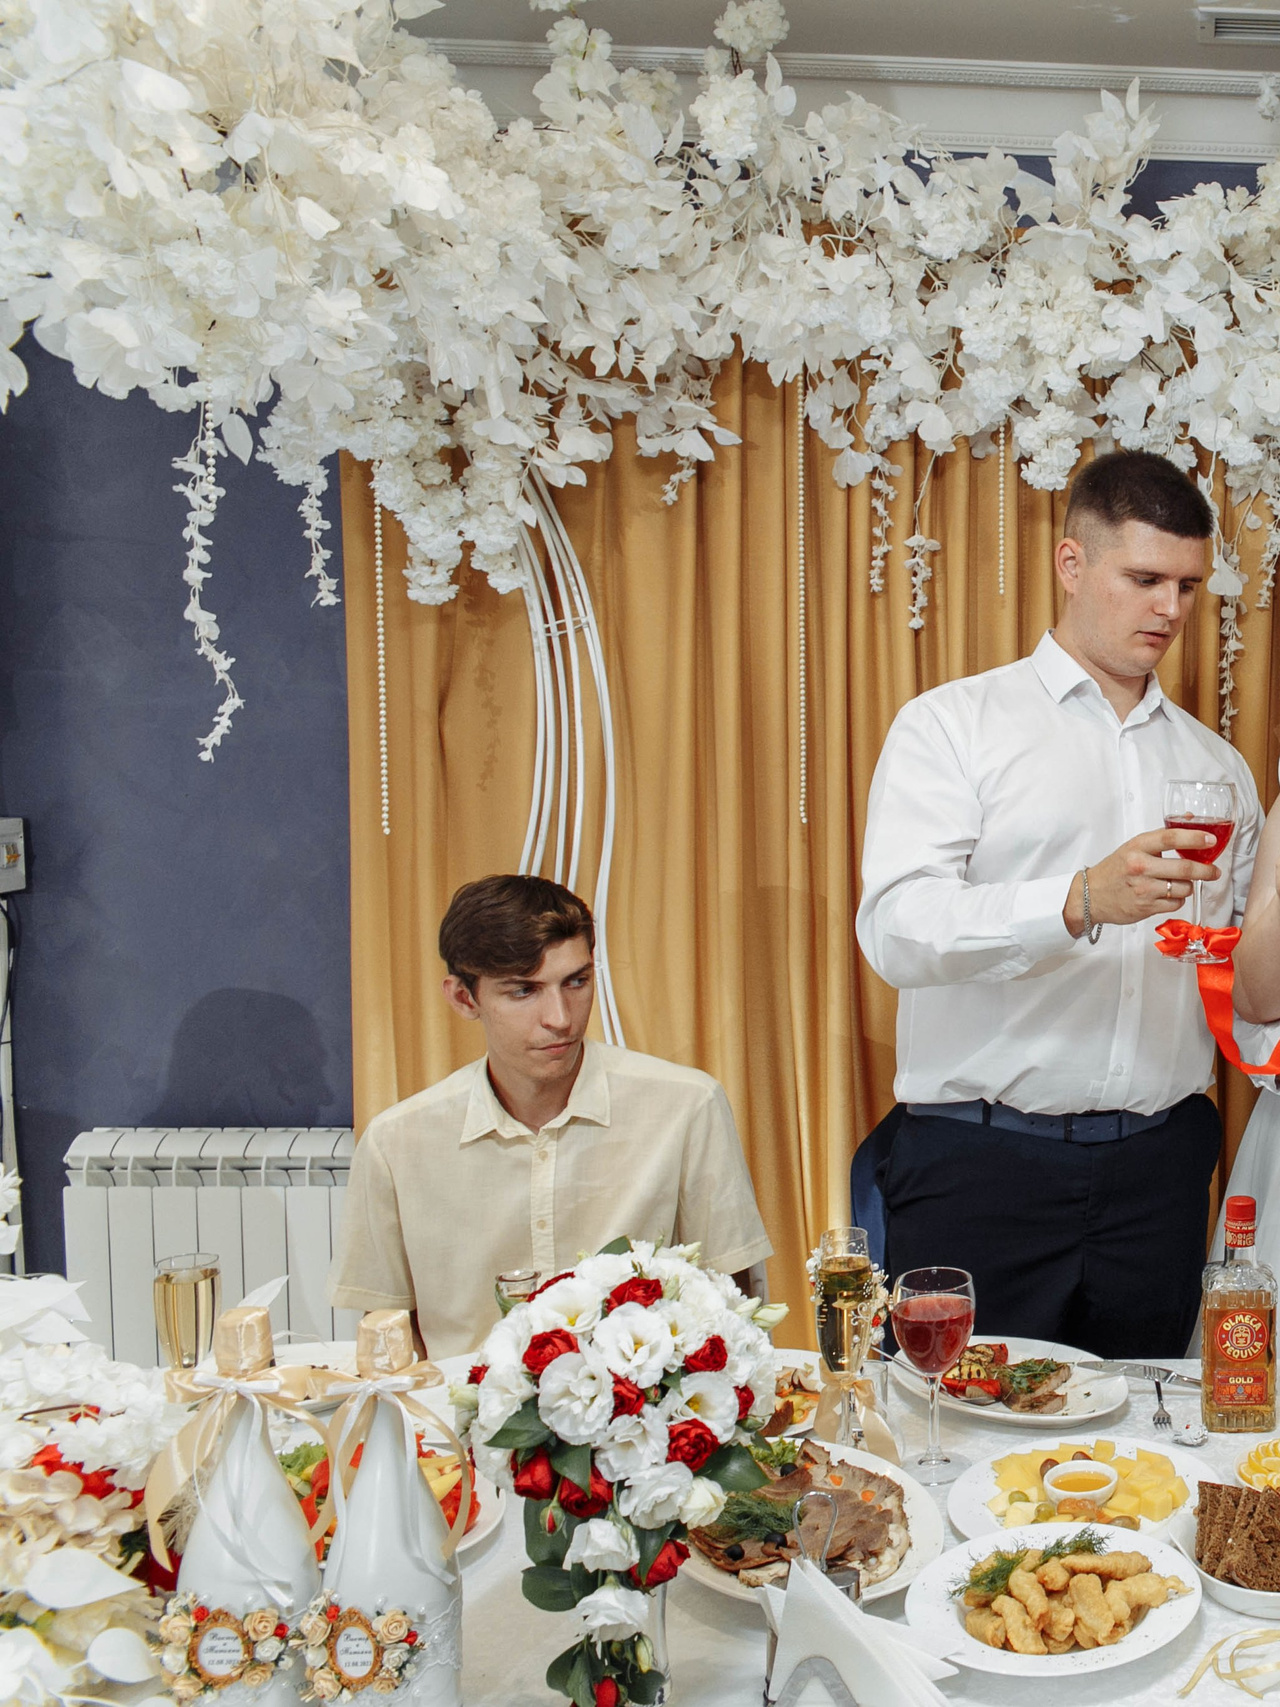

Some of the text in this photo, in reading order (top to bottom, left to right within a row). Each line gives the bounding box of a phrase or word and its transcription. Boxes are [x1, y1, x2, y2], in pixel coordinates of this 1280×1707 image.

[1222, 1314, 1262, 1331] OLMECA
[1222, 1340, 1263, 1359] TEQUILA
[1229, 1376, 1253, 1384] GOLD
